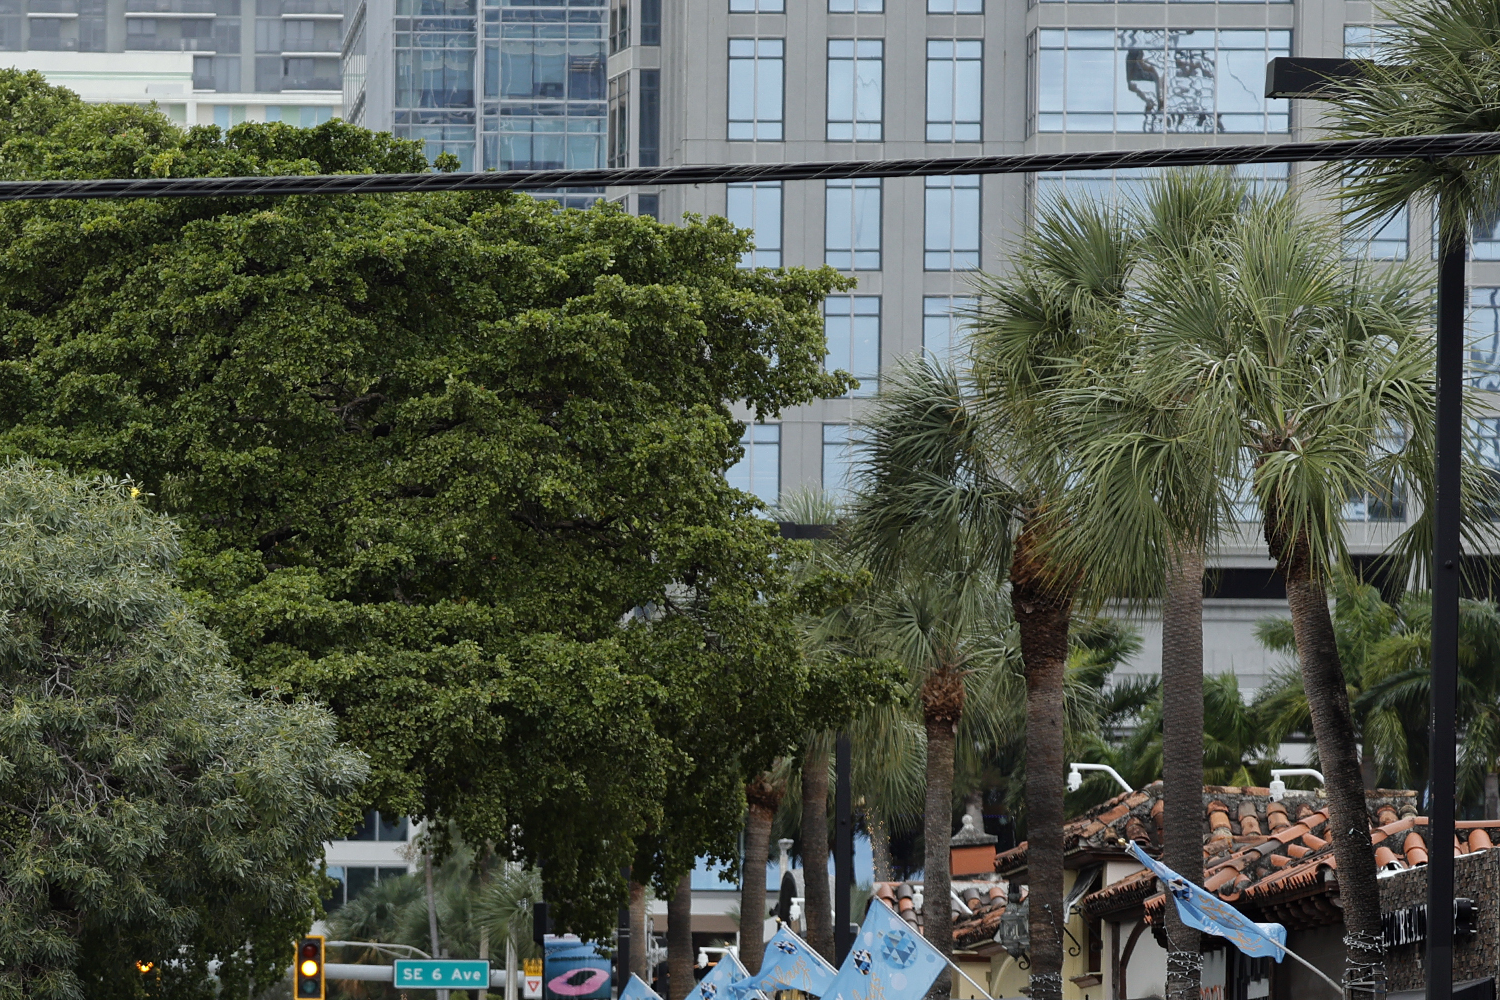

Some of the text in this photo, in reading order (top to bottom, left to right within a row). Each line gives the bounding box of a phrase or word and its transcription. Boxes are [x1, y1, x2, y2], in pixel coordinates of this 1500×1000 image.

[403, 968, 482, 980] SE 6 Ave
